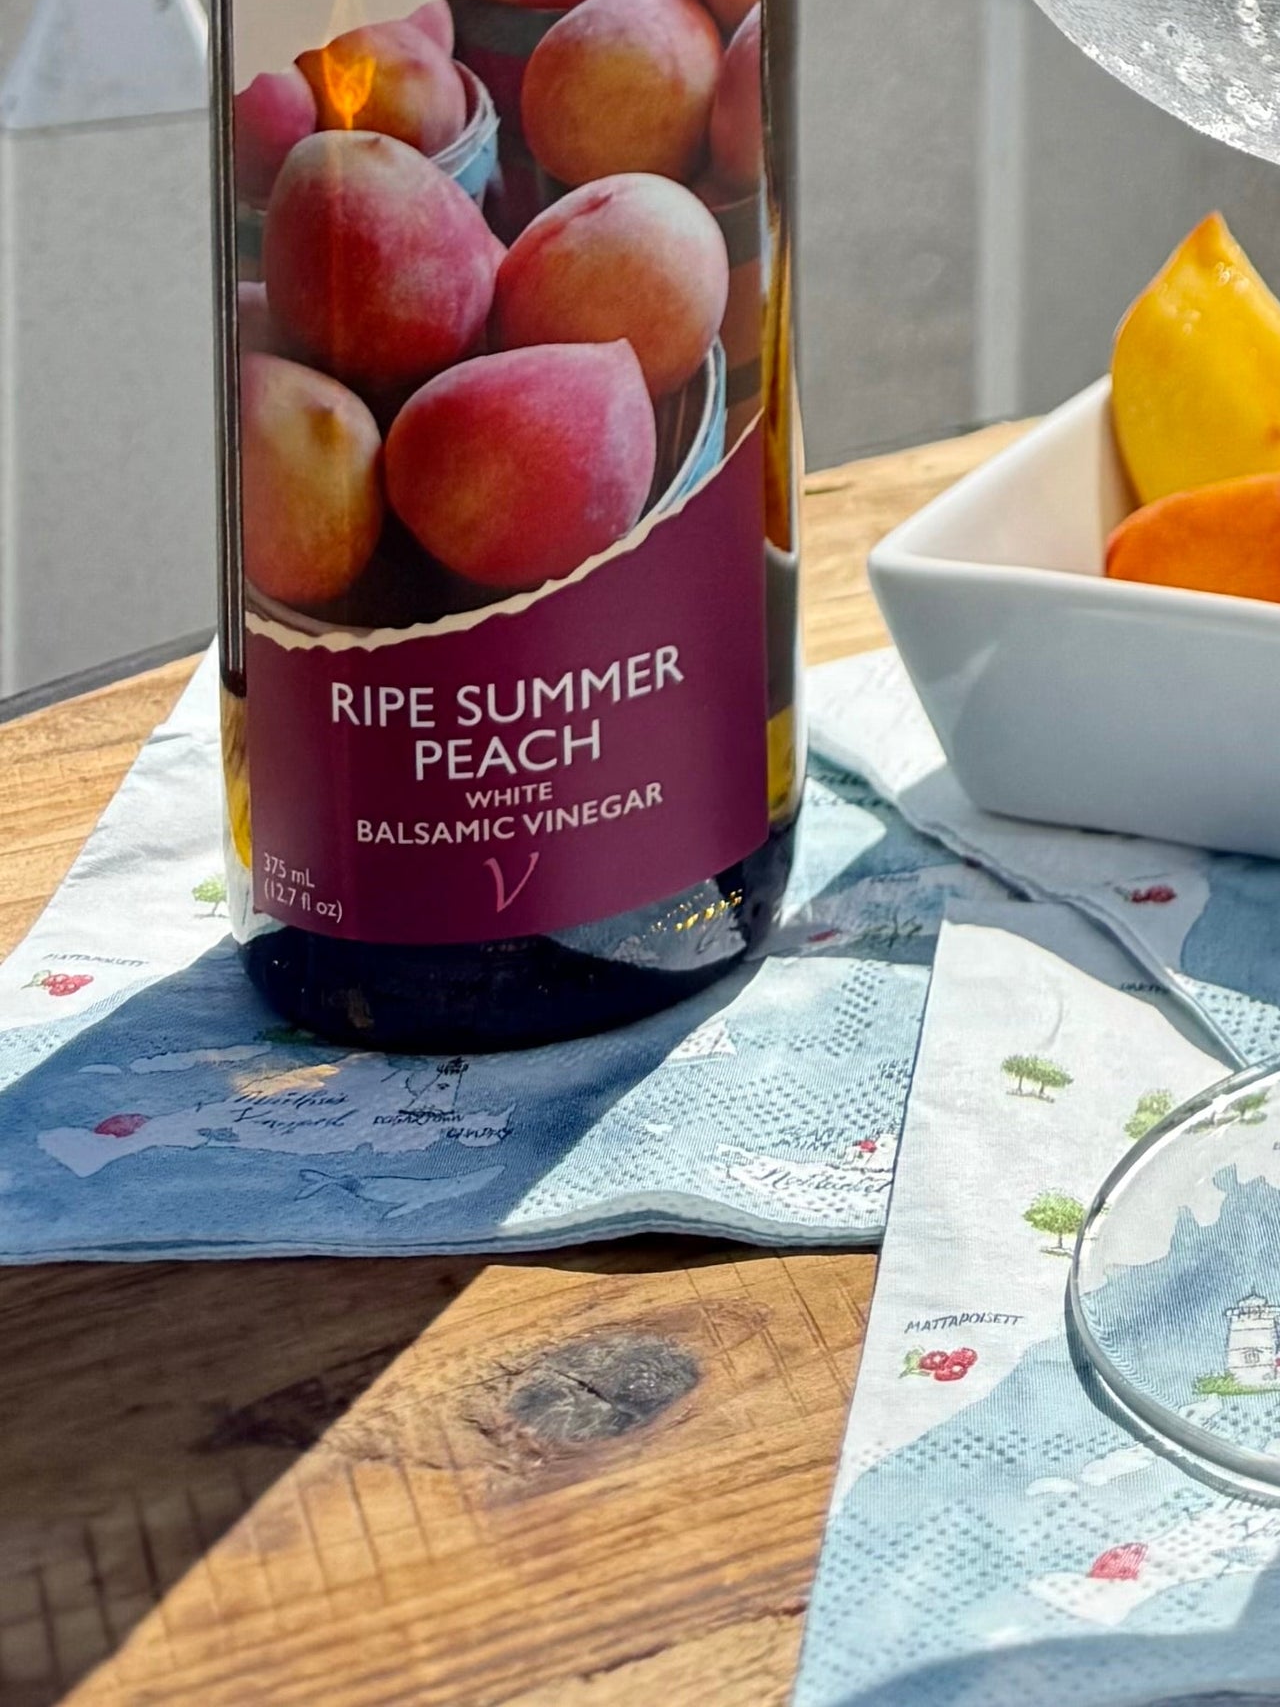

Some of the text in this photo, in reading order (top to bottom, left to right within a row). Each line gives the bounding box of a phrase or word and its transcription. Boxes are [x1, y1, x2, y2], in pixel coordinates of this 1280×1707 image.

[330, 643, 686, 729] RIPE SUMMER
[414, 717, 602, 782] PEACH
[356, 781, 665, 846] BALSAMIC VINEGAR
[464, 781, 554, 809] WHITE
[263, 851, 316, 889] 375 mL
[301, 891, 312, 912] fl
[316, 899, 343, 924] oz)
[903, 1311, 1024, 1335] MATTAPOISETT
